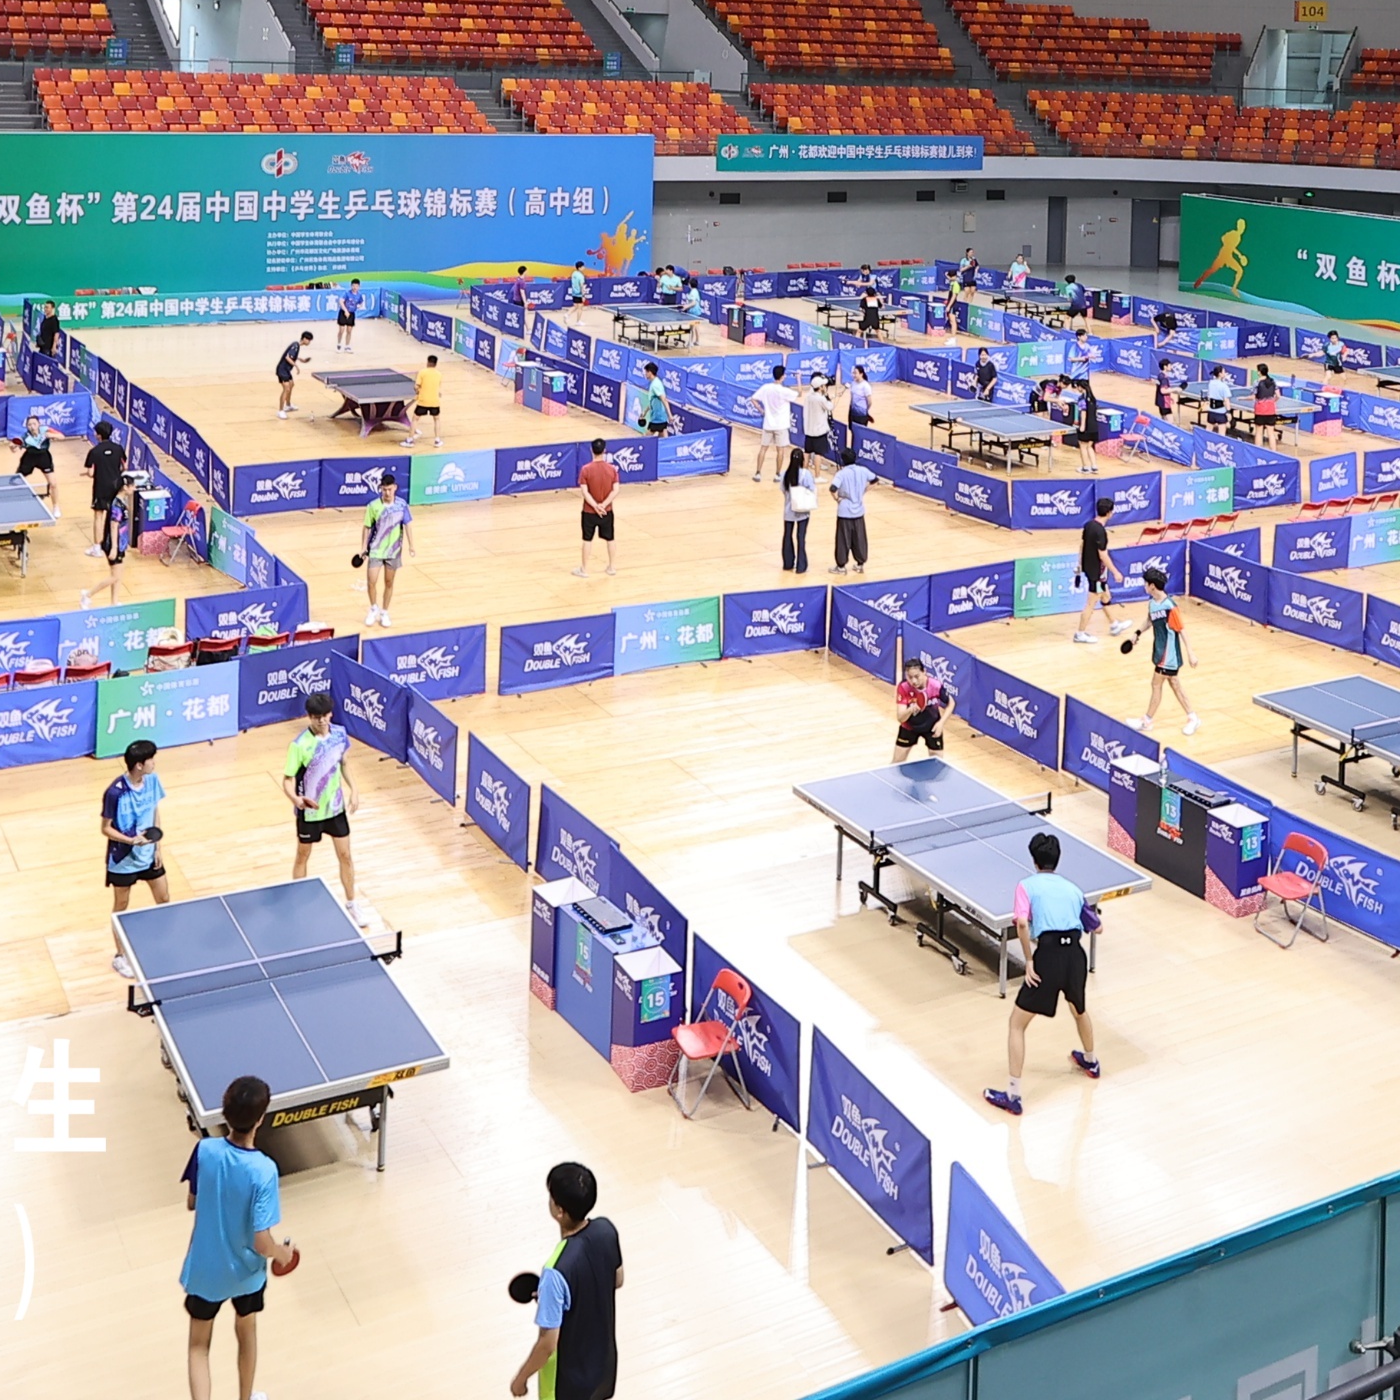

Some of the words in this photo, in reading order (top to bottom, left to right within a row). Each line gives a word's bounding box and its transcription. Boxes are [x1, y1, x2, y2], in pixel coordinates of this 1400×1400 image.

[1301, 6, 1324, 17] 104
[1236, 587, 1252, 603] FISH
[785, 621, 805, 635] FISH
[1322, 614, 1342, 631] FISH
[621, 623, 715, 652] 广州·花都
[572, 651, 591, 667] FISH
[257, 687, 298, 705] DOUBLE
[308, 678, 331, 692] FISH
[106, 692, 231, 736] 广州·花都
[48, 722, 78, 739] FISH
[1164, 803, 1177, 817] 13
[1246, 836, 1258, 849] 13
[1356, 891, 1385, 916] FISH
[578, 939, 590, 961] 15
[646, 991, 665, 1008] 15
[752, 1050, 772, 1078] FISH
[272, 1103, 328, 1129] DOUBLE
[328, 1097, 360, 1117] FISH
[831, 1115, 871, 1168] DOUBLE
[877, 1167, 899, 1201] FISH
